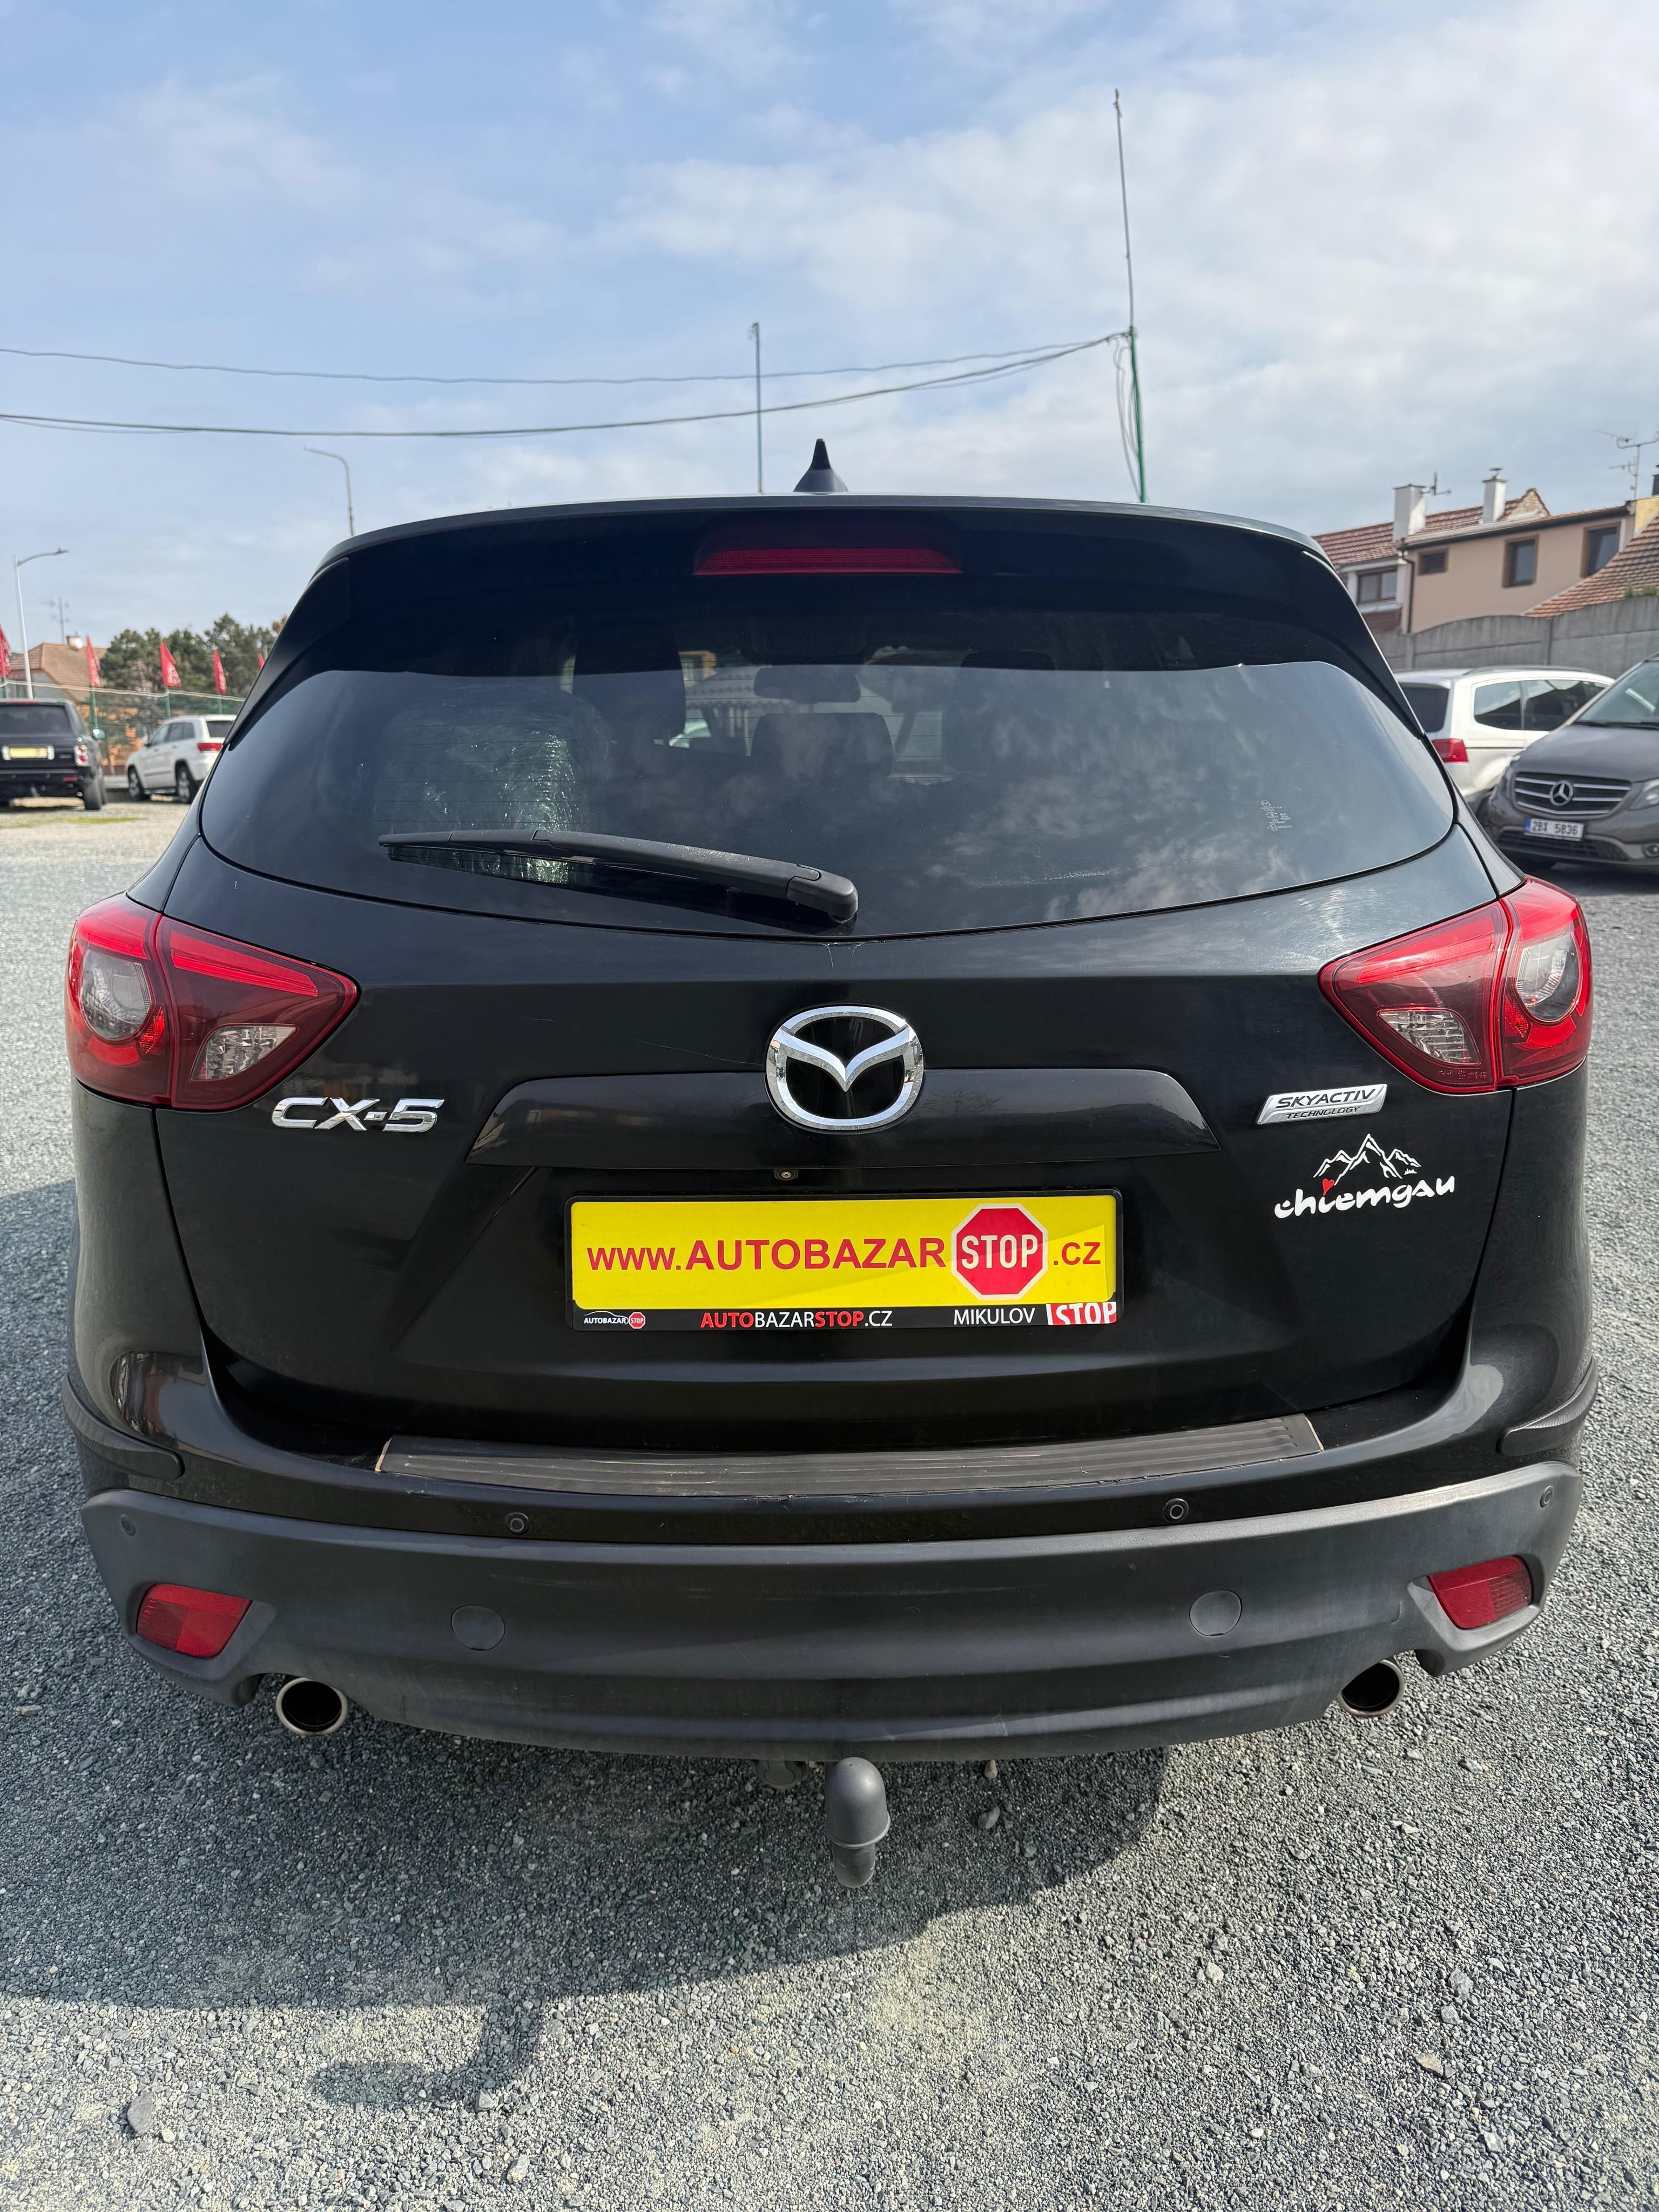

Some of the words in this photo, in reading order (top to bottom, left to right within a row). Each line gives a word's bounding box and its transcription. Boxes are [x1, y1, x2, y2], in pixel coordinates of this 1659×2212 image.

[1275, 1089, 1375, 1109] SKYACTIV
[272, 1097, 445, 1133] CX-5
[1286, 1106, 1361, 1119] TECHNOLOGY
[961, 1234, 1038, 1269] STOP
[584, 1317, 627, 1325] AUTOBAZAR
[700, 1310, 893, 1328] AUTOBAZARSTOP.CZ
[953, 1307, 1036, 1325] MIKULOV
